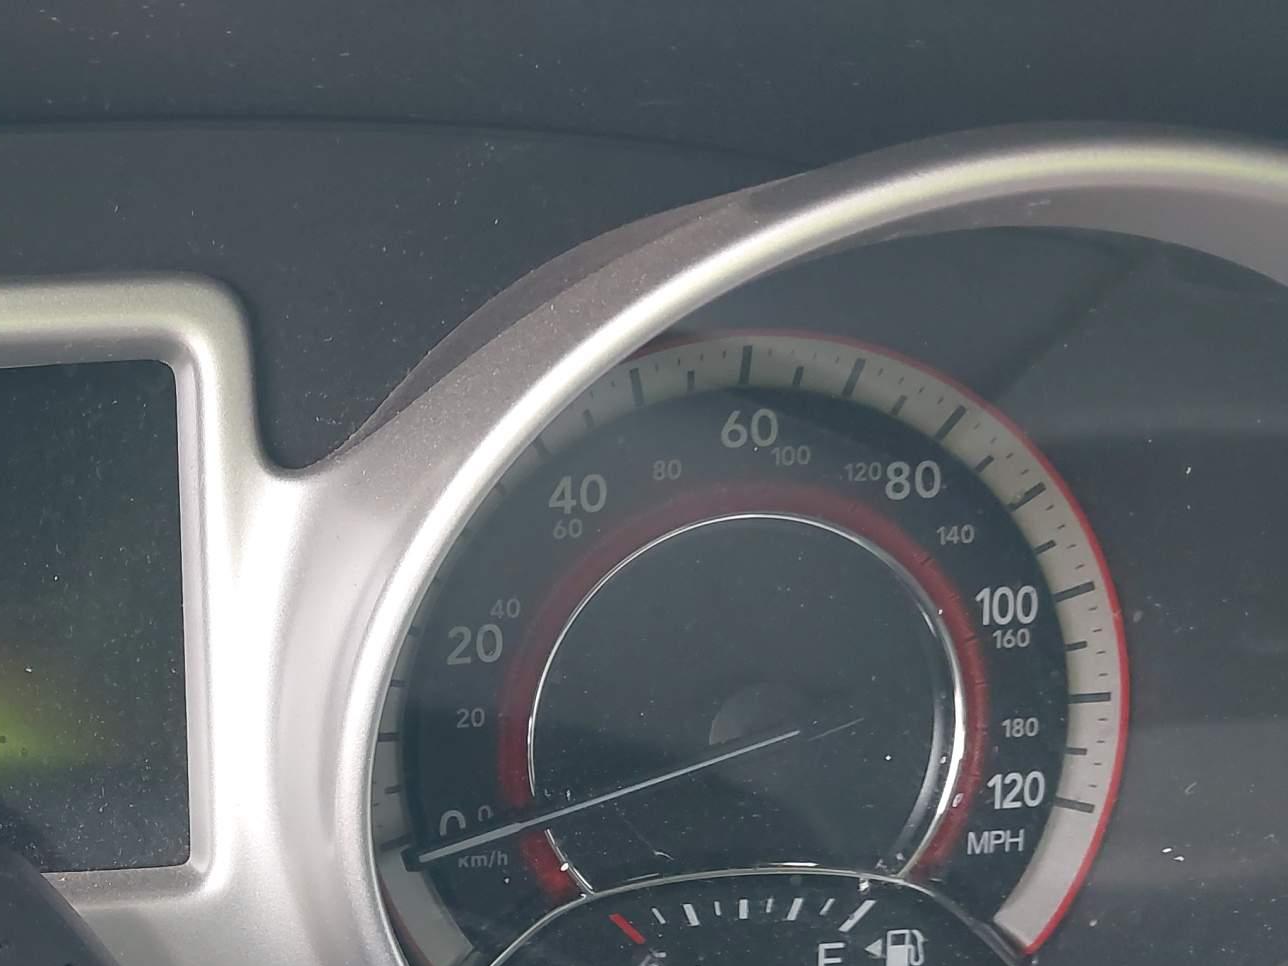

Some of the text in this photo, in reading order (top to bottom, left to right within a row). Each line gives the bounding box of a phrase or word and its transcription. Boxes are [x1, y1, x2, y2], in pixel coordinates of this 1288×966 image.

[720, 408, 779, 449] 60
[771, 445, 811, 467] 100
[652, 459, 682, 481] 80
[847, 461, 883, 482] 120
[884, 460, 942, 500] 80
[549, 474, 607, 515] 40
[552, 518, 583, 540] 60
[937, 524, 975, 546] 140
[489, 598, 521, 620] 40
[974, 586, 1039, 627] 100
[446, 624, 503, 665] 20
[992, 627, 1031, 650] 160
[456, 707, 486, 729] 20
[1001, 717, 1040, 739] 180
[987, 770, 1045, 810] 120
[966, 828, 1024, 855] MPH
